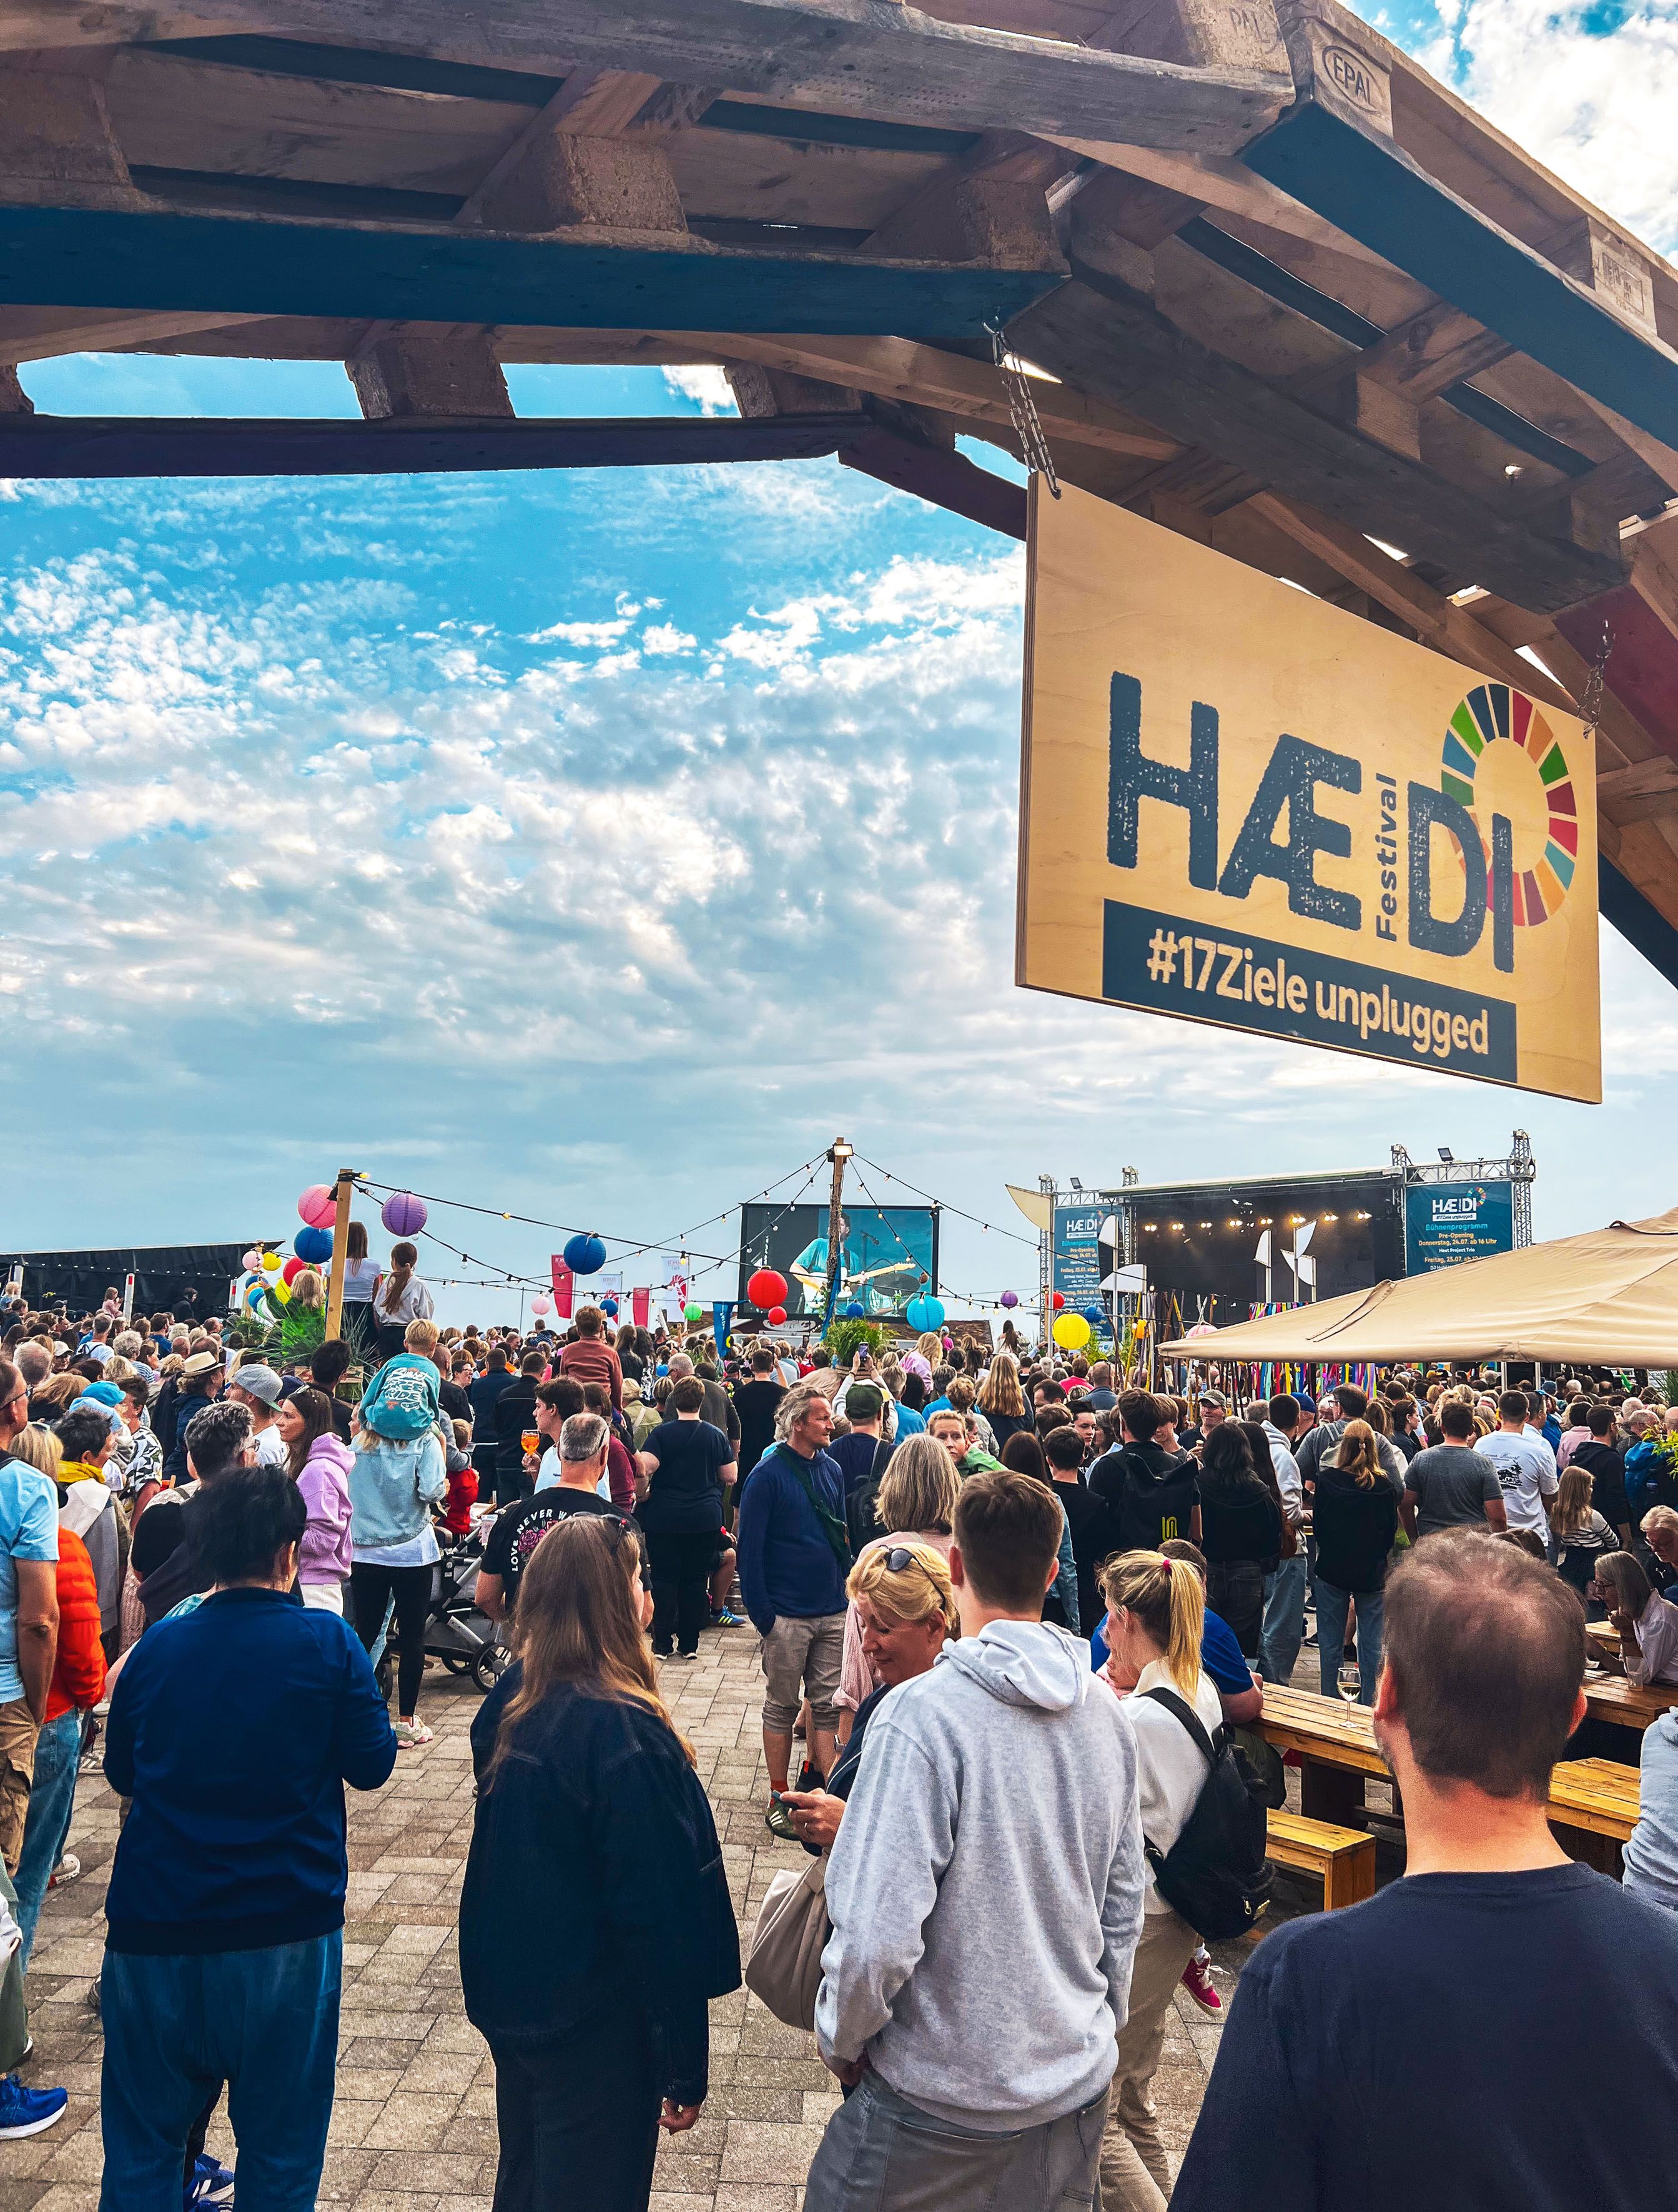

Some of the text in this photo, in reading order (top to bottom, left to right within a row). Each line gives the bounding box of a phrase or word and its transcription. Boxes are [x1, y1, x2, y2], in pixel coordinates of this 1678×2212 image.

[1107, 670, 1515, 973] HÆDI
[1376, 772, 1399, 943] Festival
[1147, 927, 1490, 1059] #17Ziele unplugged
[1426, 1223, 1488, 1231] Bühnenprogramm
[384, 1389, 422, 1402] RIDE
[510, 1508, 553, 1572] LOVE NEVER
